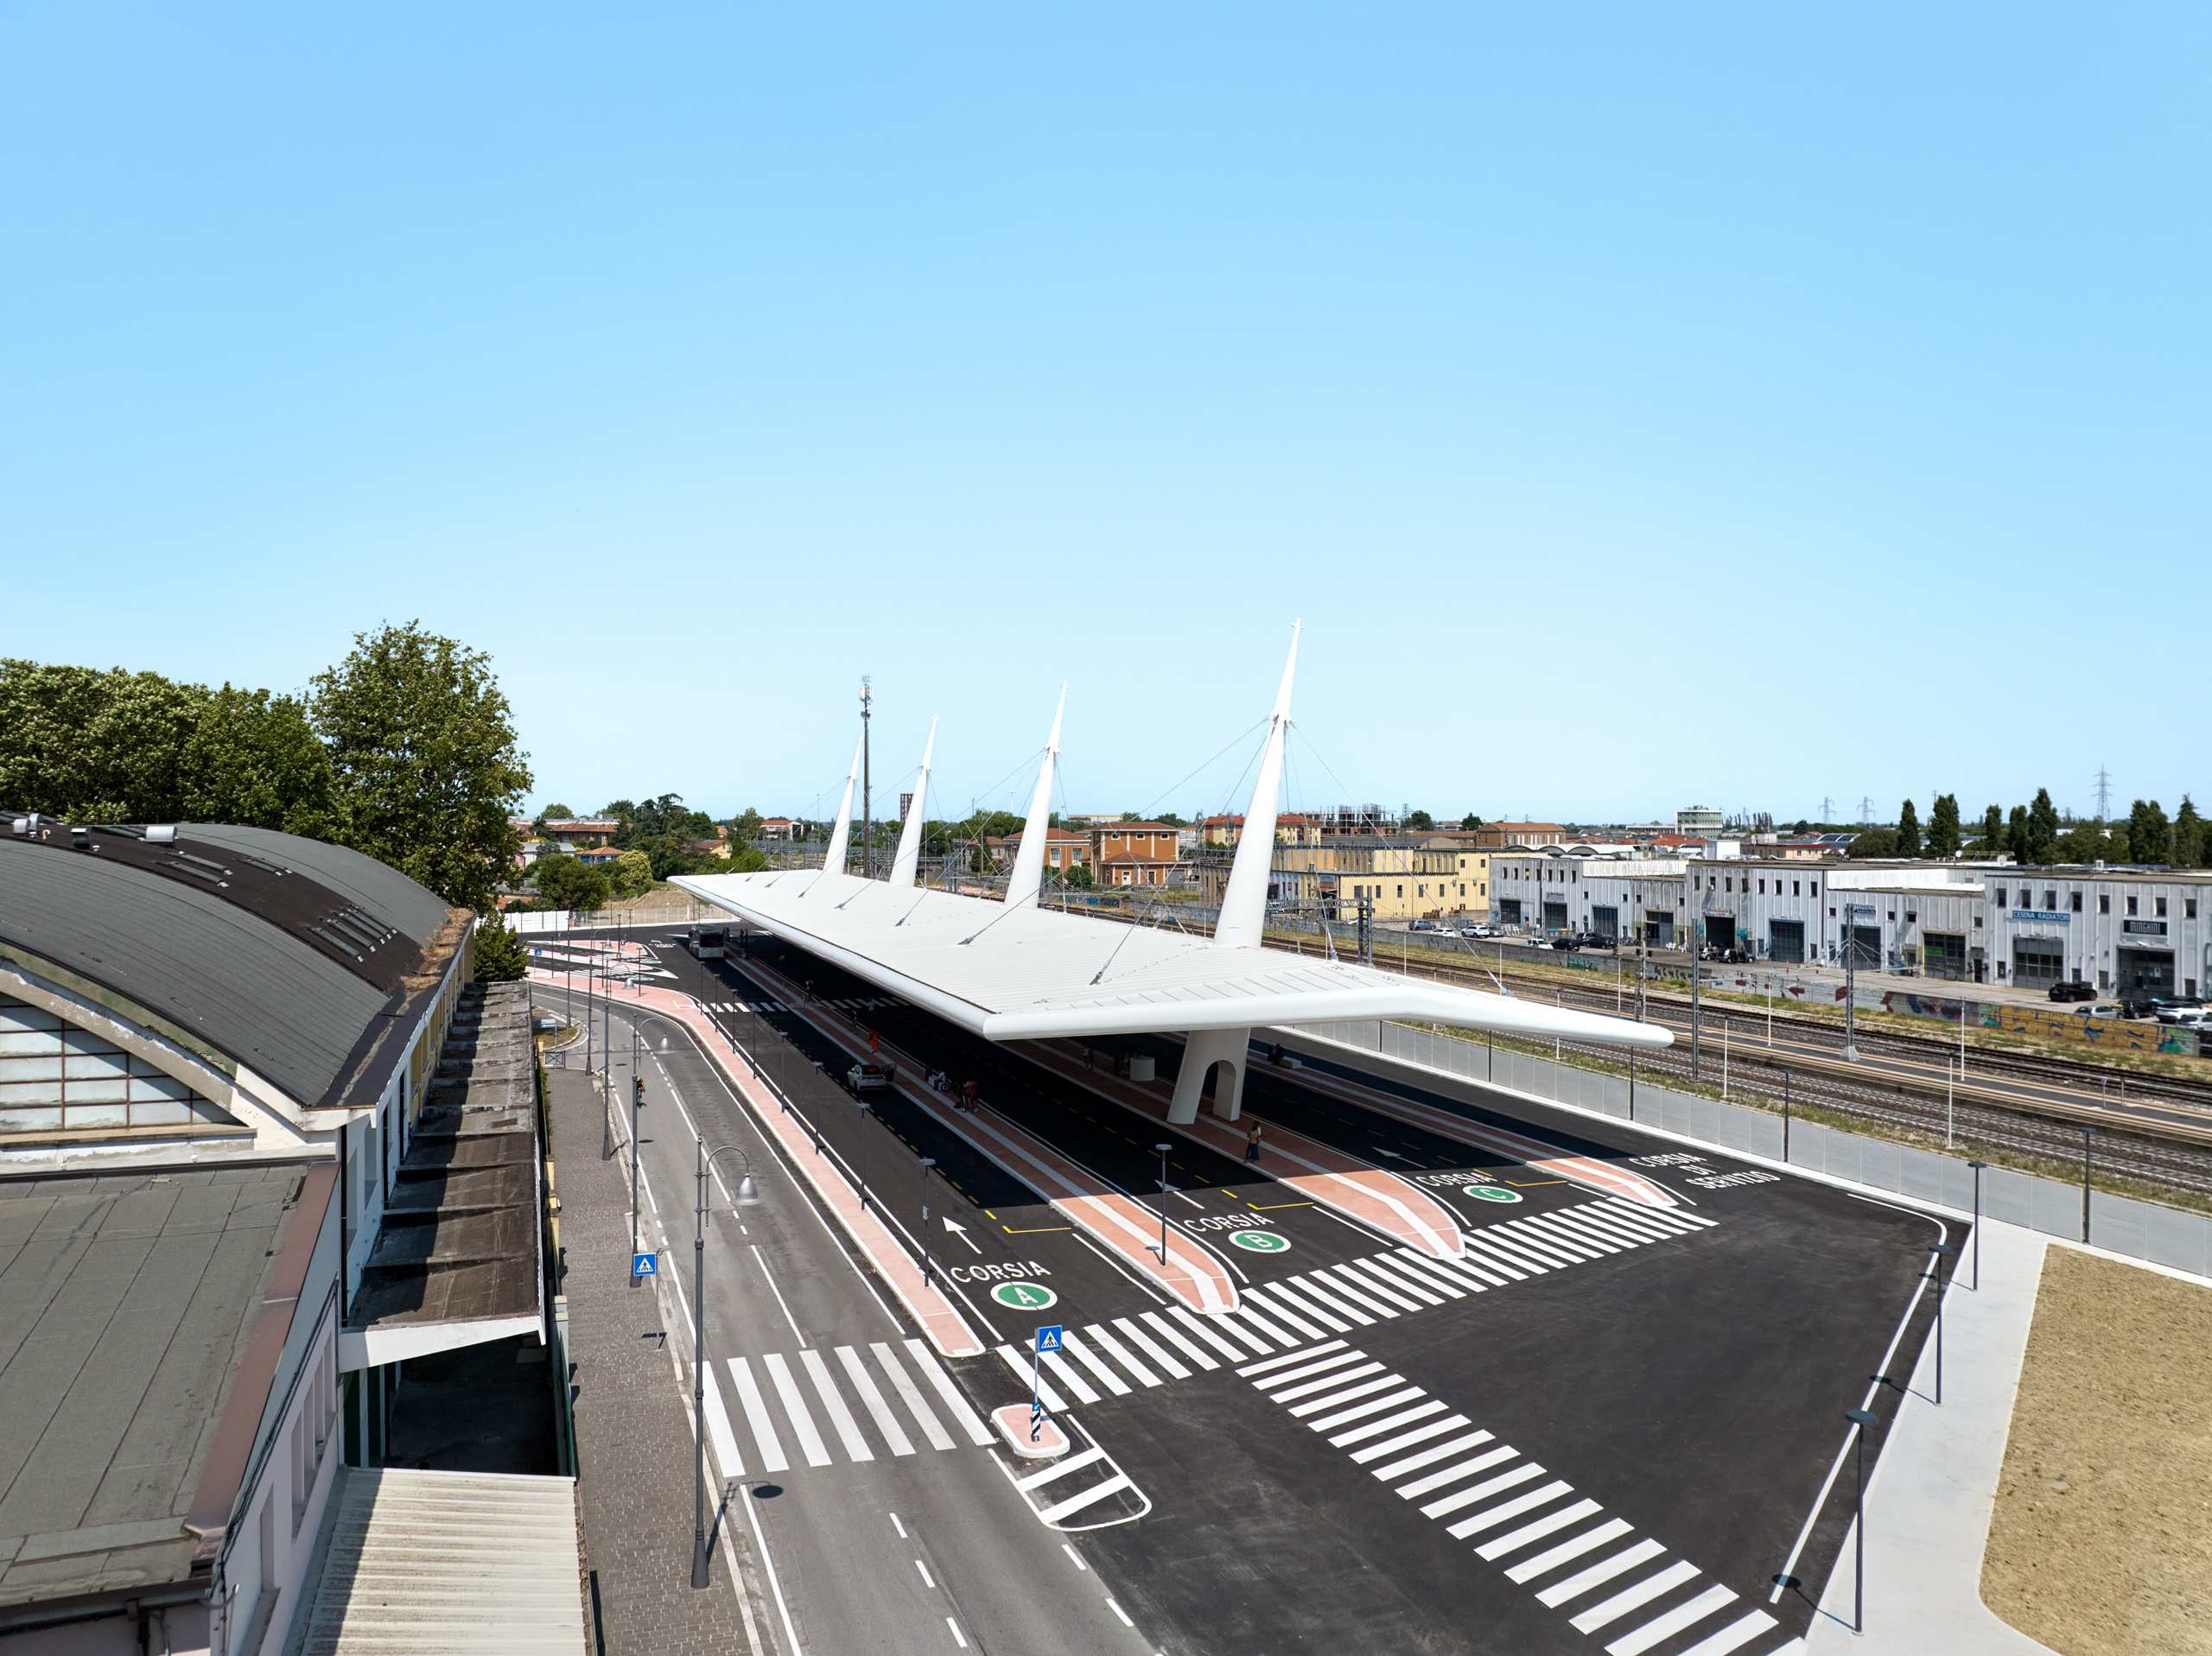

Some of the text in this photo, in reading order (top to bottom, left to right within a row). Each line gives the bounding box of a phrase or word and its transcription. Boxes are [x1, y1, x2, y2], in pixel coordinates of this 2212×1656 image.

[1629, 1152, 1707, 1167] CORSIA
[1678, 1164, 1717, 1176] DI
[1415, 1172, 1497, 1186] CORSIA
[1685, 1171, 1781, 1189] SERVIZIO
[1479, 1189, 1507, 1199] C
[1183, 1212, 1275, 1232] CORSIA
[1244, 1234, 1273, 1247] B
[950, 1260, 1052, 1283] CORSIA
[1014, 1287, 1039, 1304] A
